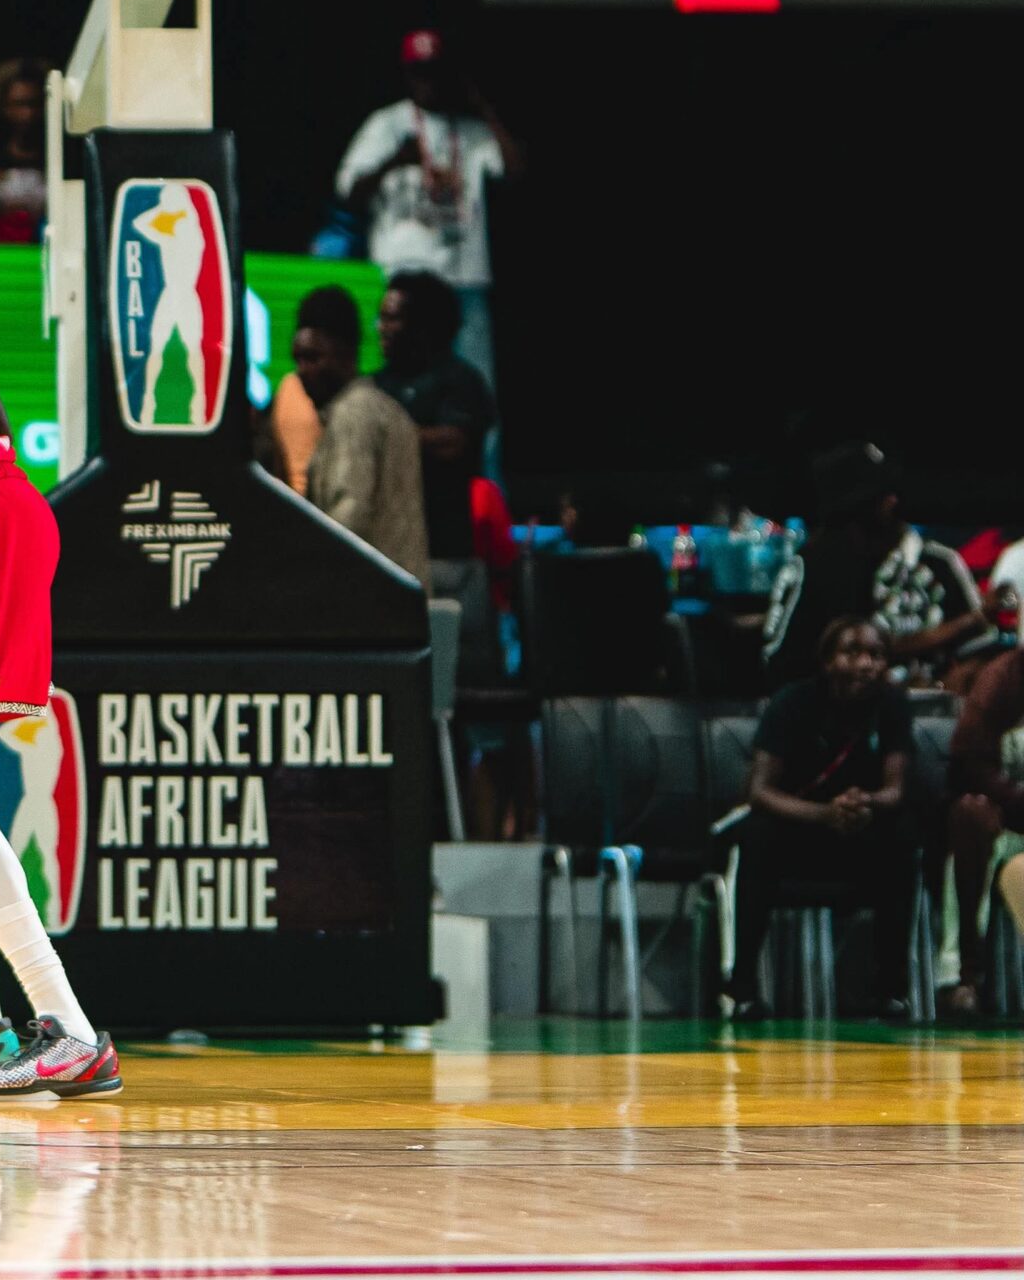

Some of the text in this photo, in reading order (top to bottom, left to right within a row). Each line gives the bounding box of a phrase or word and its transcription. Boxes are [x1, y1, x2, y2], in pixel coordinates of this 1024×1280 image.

[125, 240, 145, 358] BAL
[97, 693, 394, 766] BASKETBALL
[97, 775, 270, 848] AFRICA
[97, 856, 279, 931] LEAGUE
